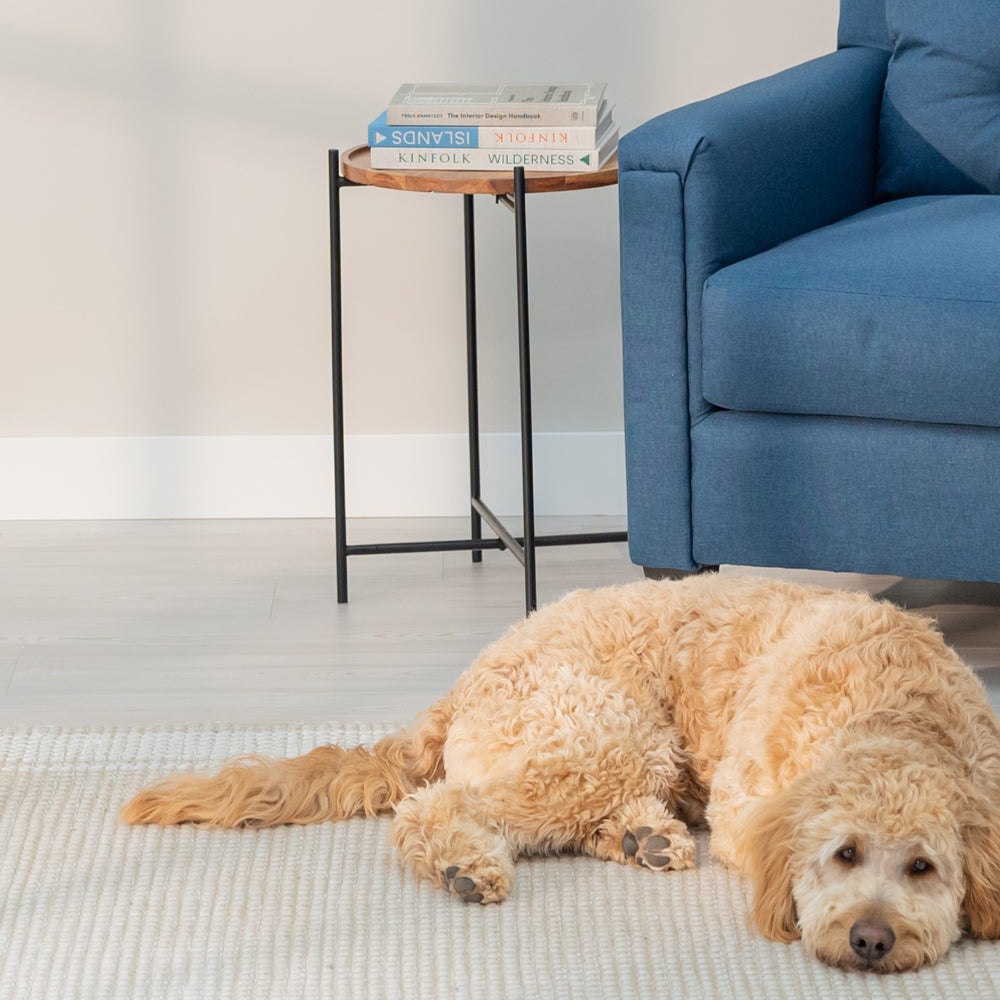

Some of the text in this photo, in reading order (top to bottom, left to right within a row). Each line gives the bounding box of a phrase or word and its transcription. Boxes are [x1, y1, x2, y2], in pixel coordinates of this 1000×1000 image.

[485, 112, 507, 120] Design
[391, 130, 568, 145] KINFOLK ISLANDS
[398, 152, 574, 165] KINFOLK WILDERNESS
